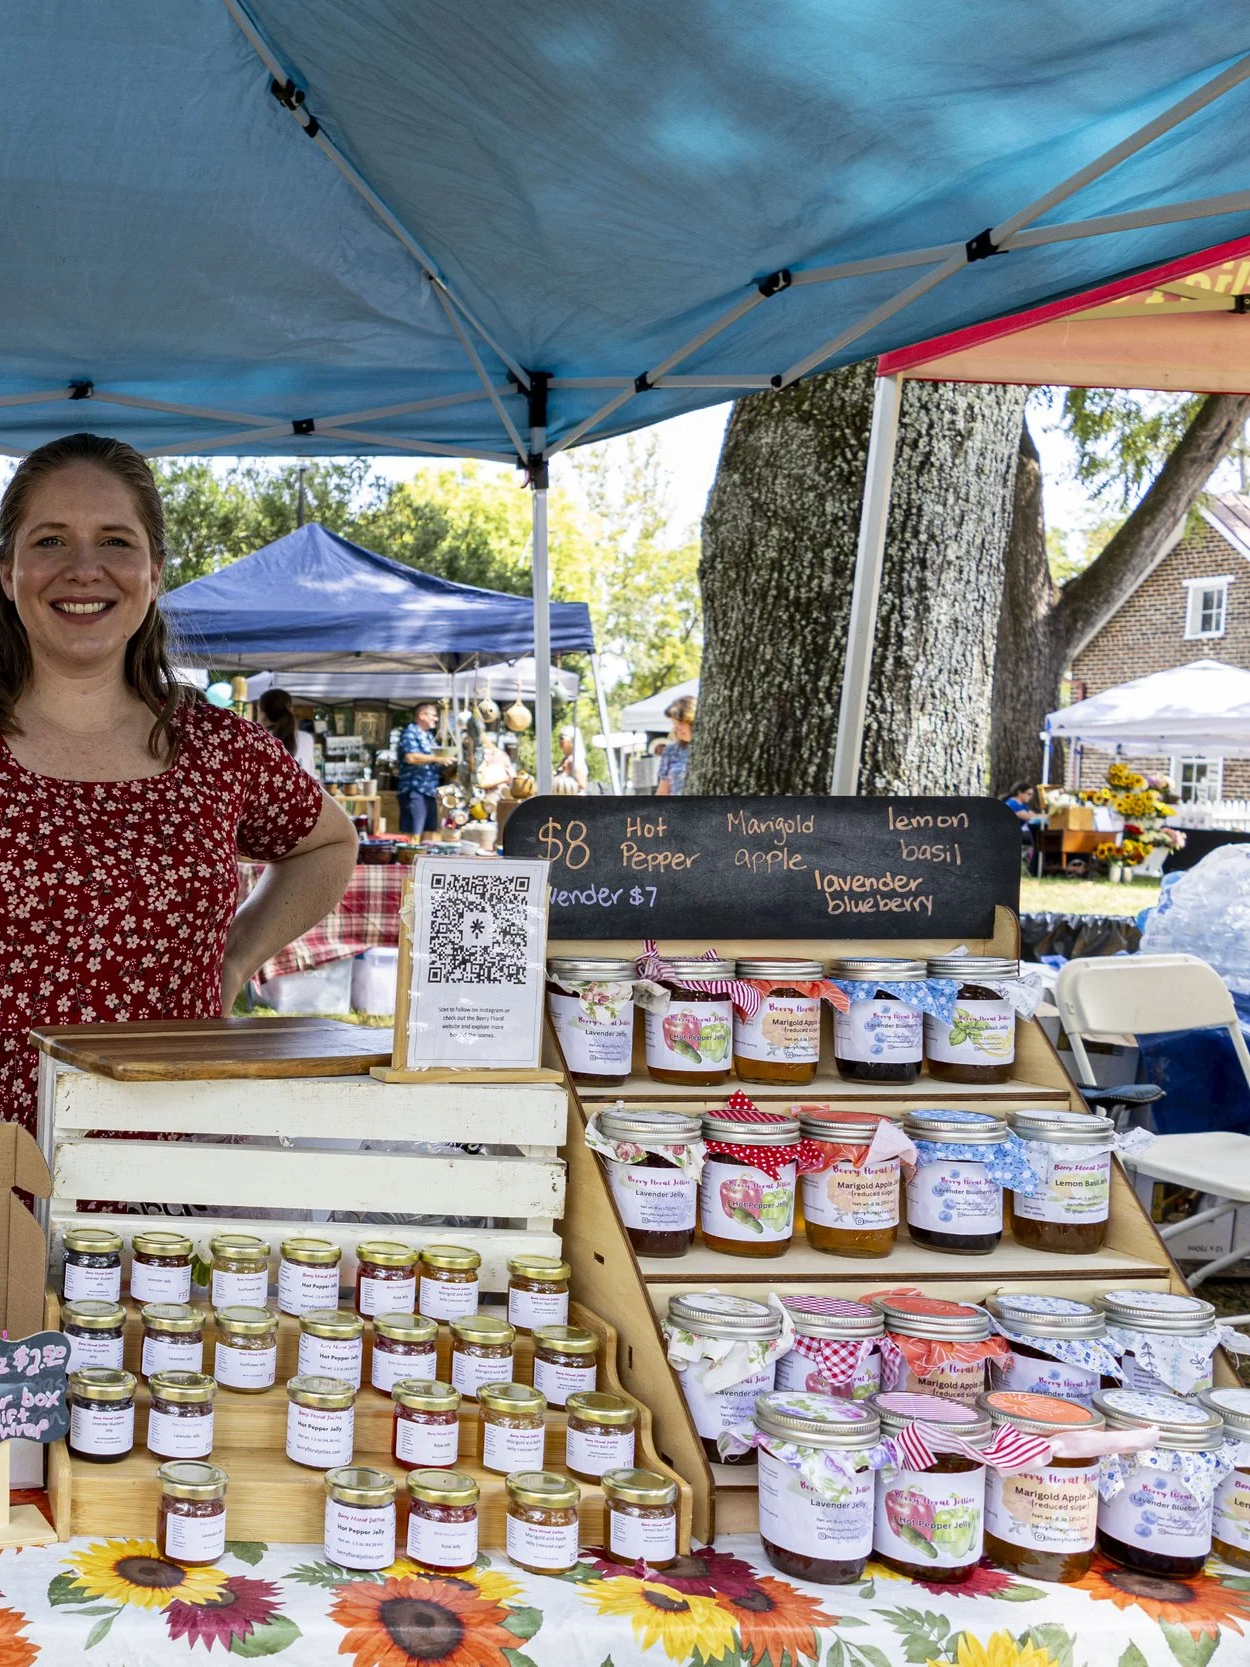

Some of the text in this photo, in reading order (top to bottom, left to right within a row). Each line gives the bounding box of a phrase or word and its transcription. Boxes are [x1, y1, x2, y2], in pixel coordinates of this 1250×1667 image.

[626, 817, 667, 838] Hot
[727, 809, 815, 845] Marigold
[888, 806, 968, 830] lemon
[538, 816, 590, 870] $8
[901, 839, 961, 865] basil
[621, 842, 700, 872] Pepper
[734, 848, 807, 873] apple
[815, 870, 923, 892] lavender
[550, 884, 657, 907] vender $7
[825, 895, 932, 916] blueberry
[838, 1182, 873, 1190] Marigold
[1056, 1179, 1083, 1187] Lemon
[636, 1190, 668, 1198] Lavender
[918, 1378, 958, 1388] Marigold
[21, 1387, 61, 1408] box
[811, 1499, 850, 1509] Lavender
[1015, 1486, 1086, 1502] Marigold Apple
[1134, 1495, 1170, 1508] Lavender
[349, 1527, 370, 1535] Pepper
[954, 1521, 971, 1529] Jelly
